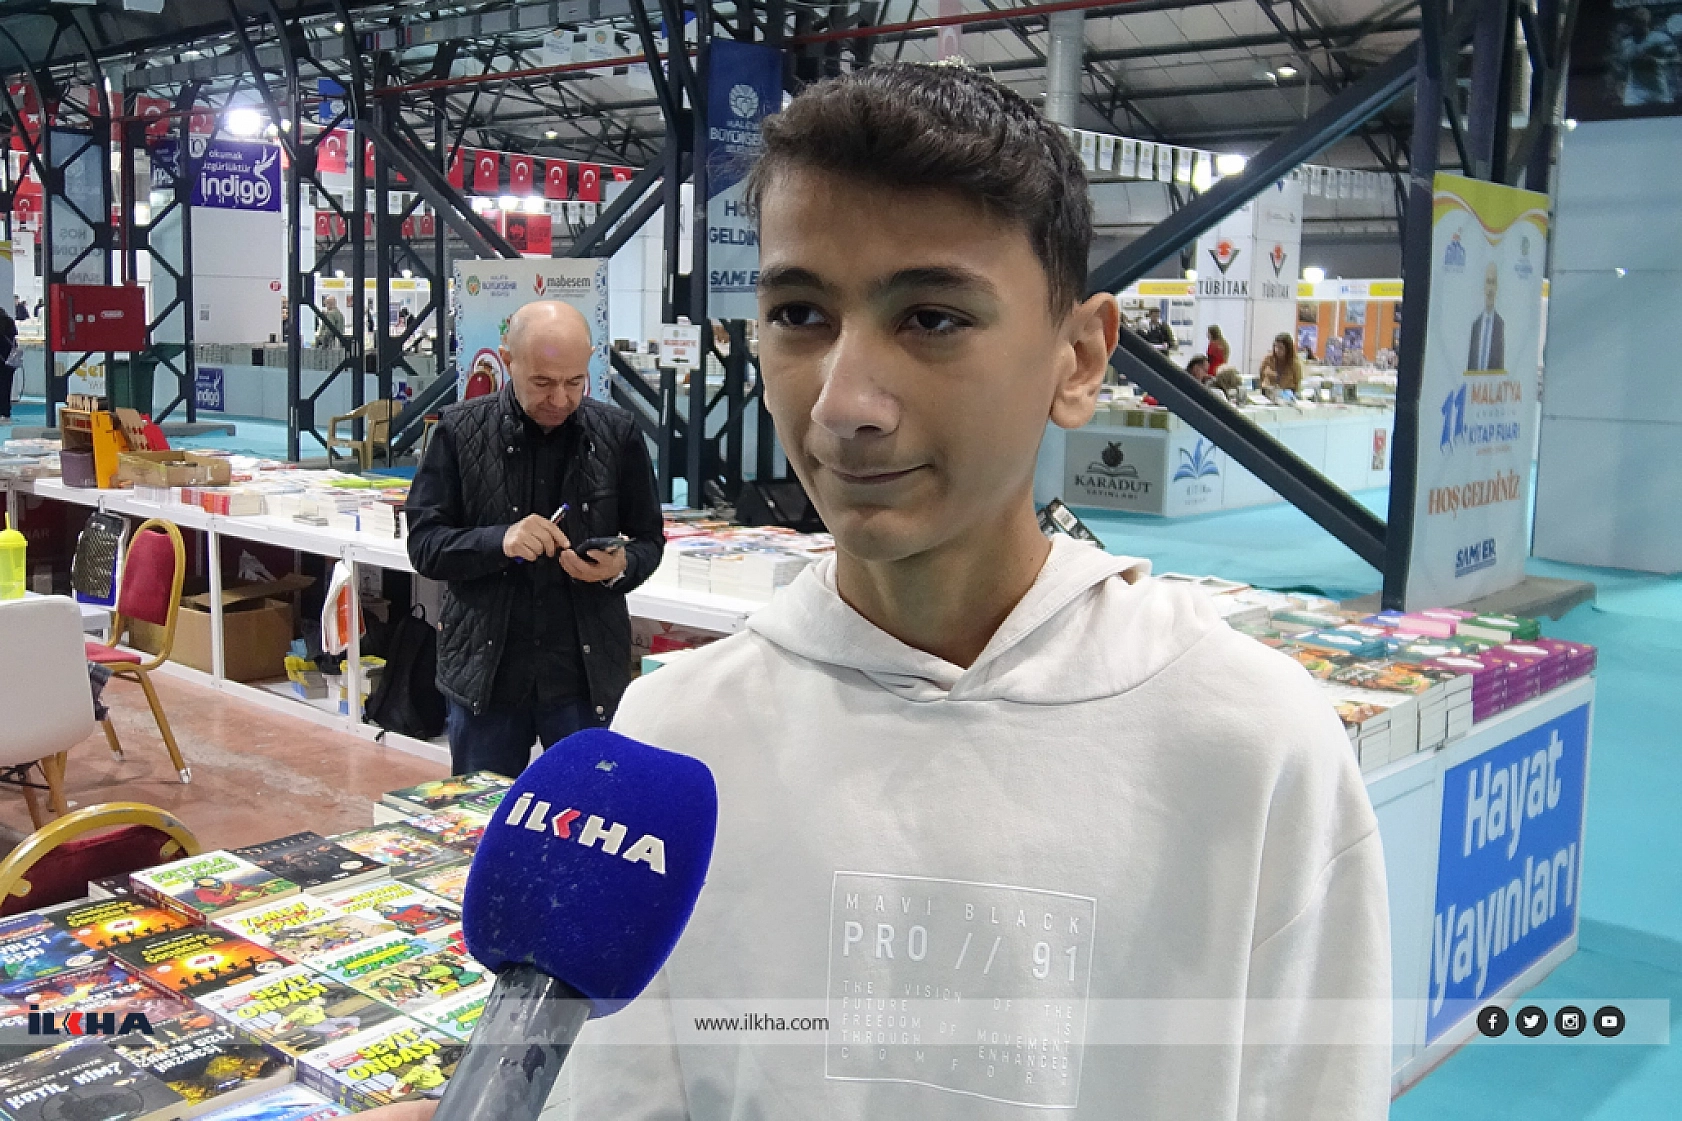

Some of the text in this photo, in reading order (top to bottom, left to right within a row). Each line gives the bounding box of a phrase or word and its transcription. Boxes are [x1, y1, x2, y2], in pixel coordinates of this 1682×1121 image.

[201, 172, 267, 204] indigo
[547, 274, 591, 287] mabesem
[749, 270, 760, 285] E
[1198, 276, 1248, 295] TÜBİTAK
[1262, 280, 1290, 299] TÜBİTAK
[1470, 380, 1522, 405] MALATYA
[1075, 474, 1152, 494] KARADUT
[1428, 469, 1520, 520] HOŞ GELDİNİZ
[1463, 728, 1563, 861] Hayat
[965, 903, 1080, 934] BLACK
[842, 921, 928, 962] PRO
[1032, 941, 1078, 981] 91
[842, 980, 1072, 1018] THE VISION OF THE
[842, 1012, 1070, 1052] FREEDOM OF MOVEMENT
[843, 996, 1071, 1036] FUTURE IS
[357, 1027, 419, 1060] SEYİT
[841, 1029, 1068, 1071] THROUGH ENHANCED
